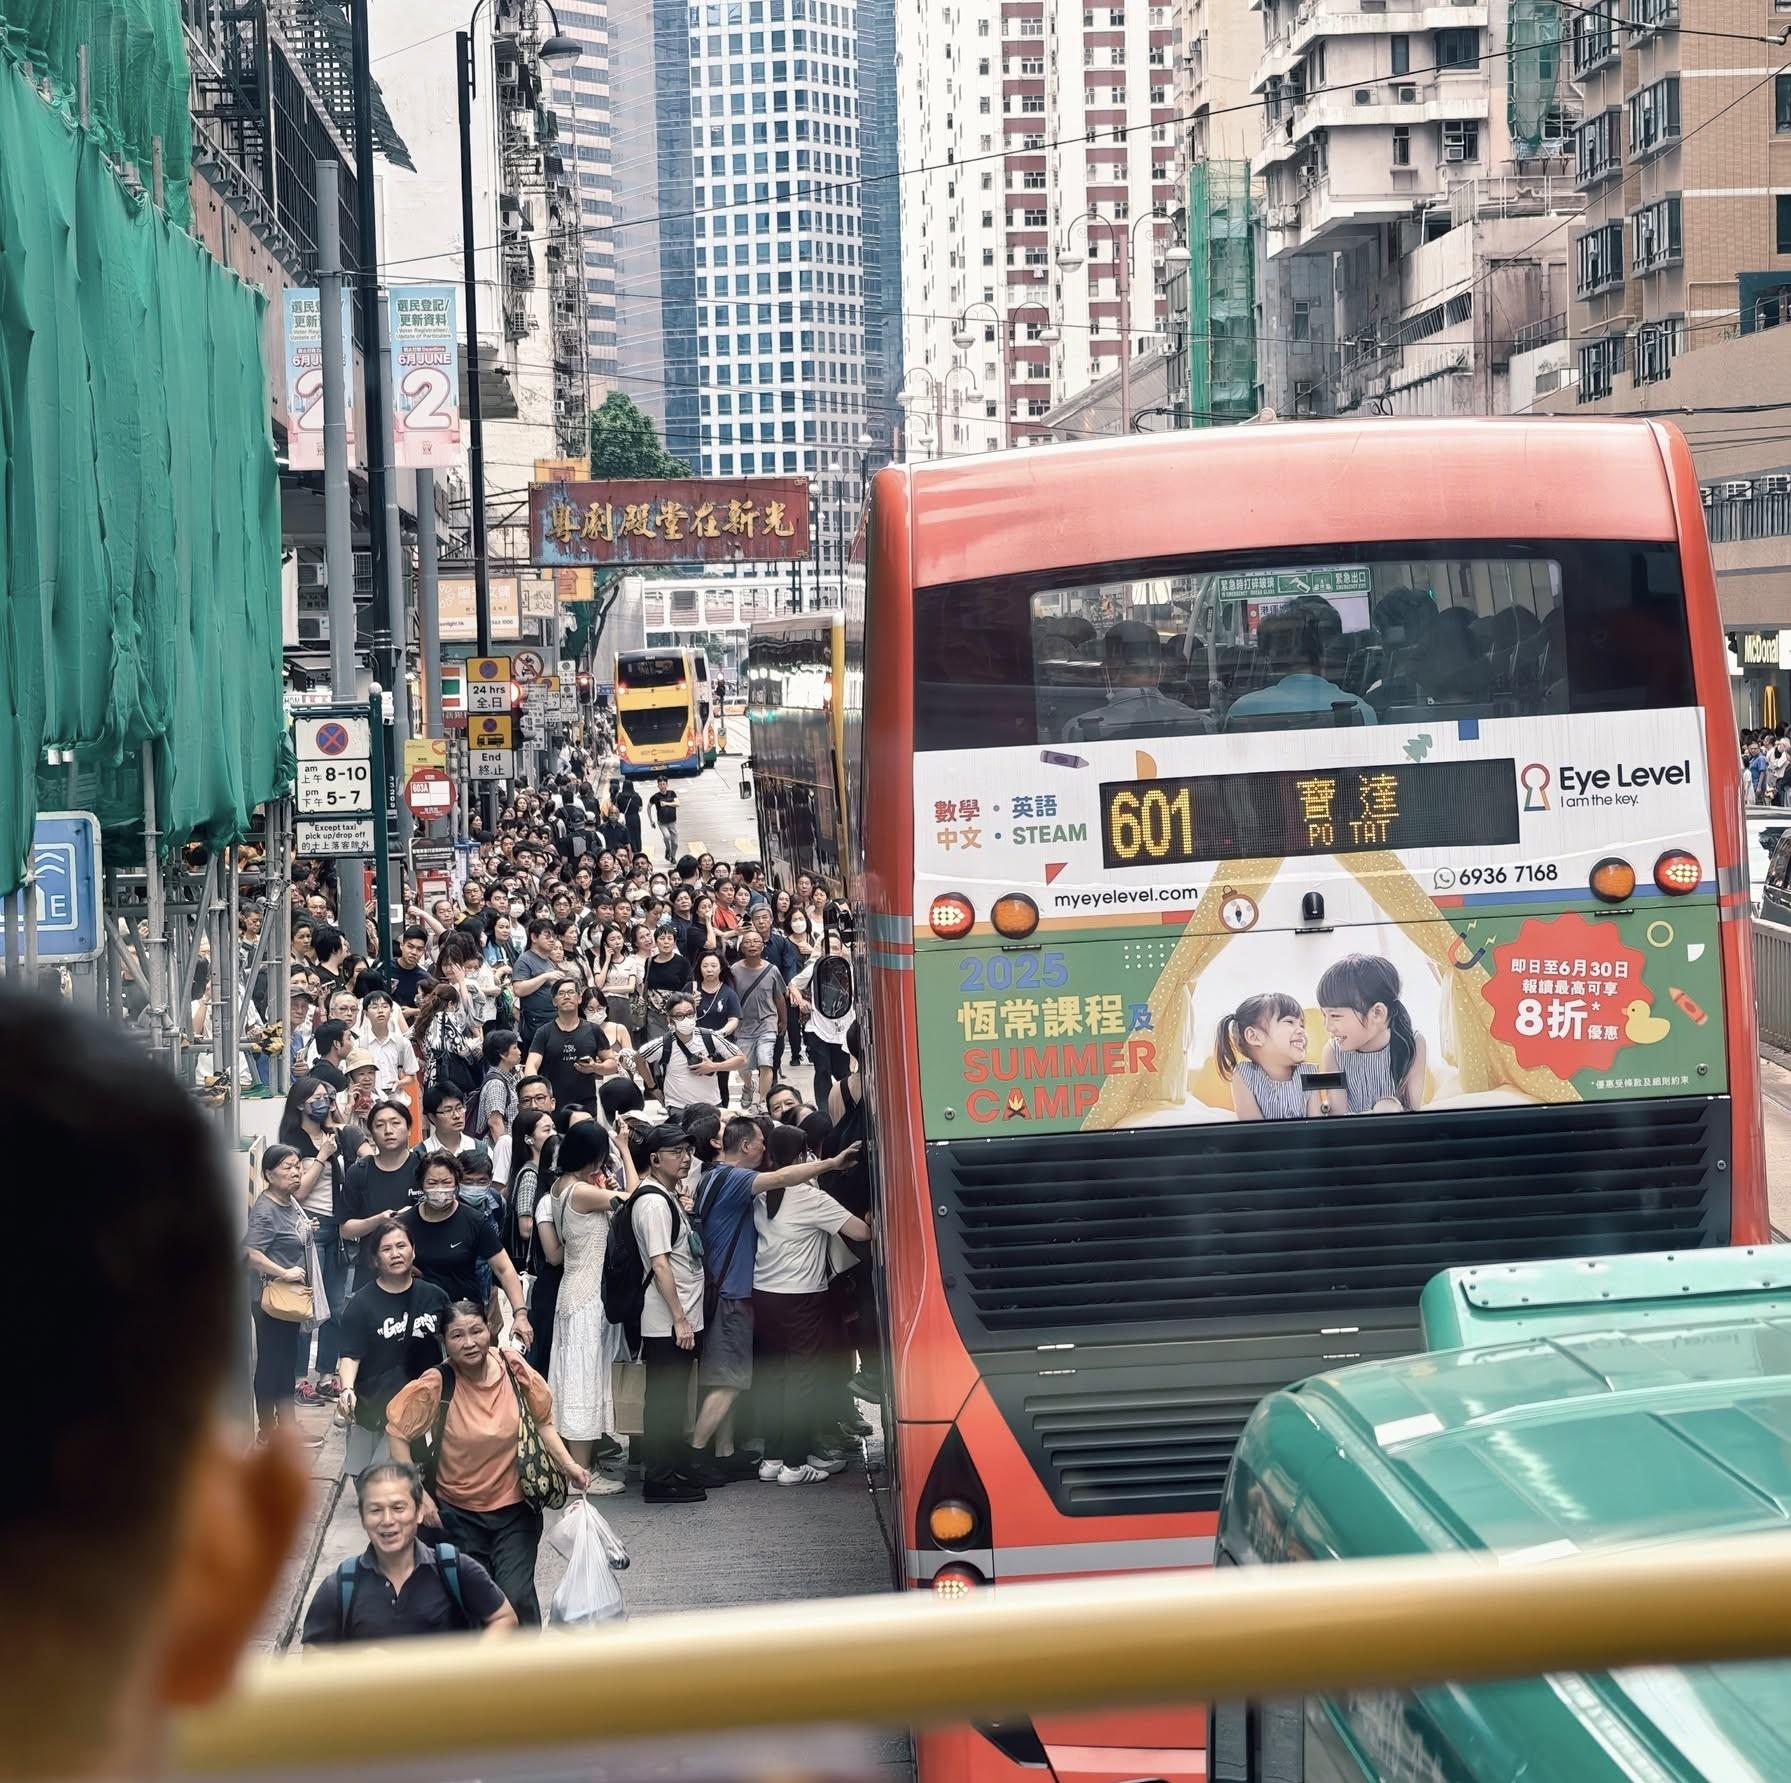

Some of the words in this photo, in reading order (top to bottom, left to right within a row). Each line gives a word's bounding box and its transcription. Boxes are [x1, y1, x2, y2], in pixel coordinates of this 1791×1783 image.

[400, 313, 447, 326] 更新資料
[401, 367, 452, 431] 2
[1336, 571, 1366, 584] 緊急出口
[472, 686, 487, 694] 24
[490, 685, 506, 694] hrs
[477, 697, 502, 708] 全日
[482, 753, 501, 761] End
[325, 767, 367, 782] 8-10
[478, 765, 504, 775] 終止
[1559, 765, 1611, 796] Eye
[1617, 760, 1691, 787] Level
[301, 774, 322, 784] 上午
[412, 783, 429, 793] 603A
[301, 798, 323, 808] 下午
[327, 791, 361, 805] 5-7
[1560, 796, 1564, 808] I
[1565, 797, 1589, 807] am
[1591, 794, 1612, 806] the
[1614, 793, 1639, 808] key.
[934, 799, 980, 823] 數學
[1012, 794, 1058, 818] 英語
[314, 824, 339, 833] Except
[1111, 787, 1193, 859] 601
[305, 832, 320, 840] pick
[936, 826, 982, 851] 中文
[1012, 823, 1088, 845] STEAM
[1309, 823, 1334, 847] PO
[1349, 819, 1392, 844] TAT
[301, 840, 369, 850] 的士上落客除外
[1459, 867, 1508, 886] 6936
[1515, 864, 1558, 883] 7168
[50, 894, 67, 918] E
[1054, 886, 1198, 909] myeyelevel.com
[959, 952, 1069, 992] 2025
[1511, 959, 1629, 979] 即日至6月30日
[1522, 979, 1618, 997] 報讀最高可享
[1587, 1024, 1619, 1041] 優惠
[963, 1040, 1158, 1084] SUMMER
[966, 1083, 1100, 1123] CAMP
